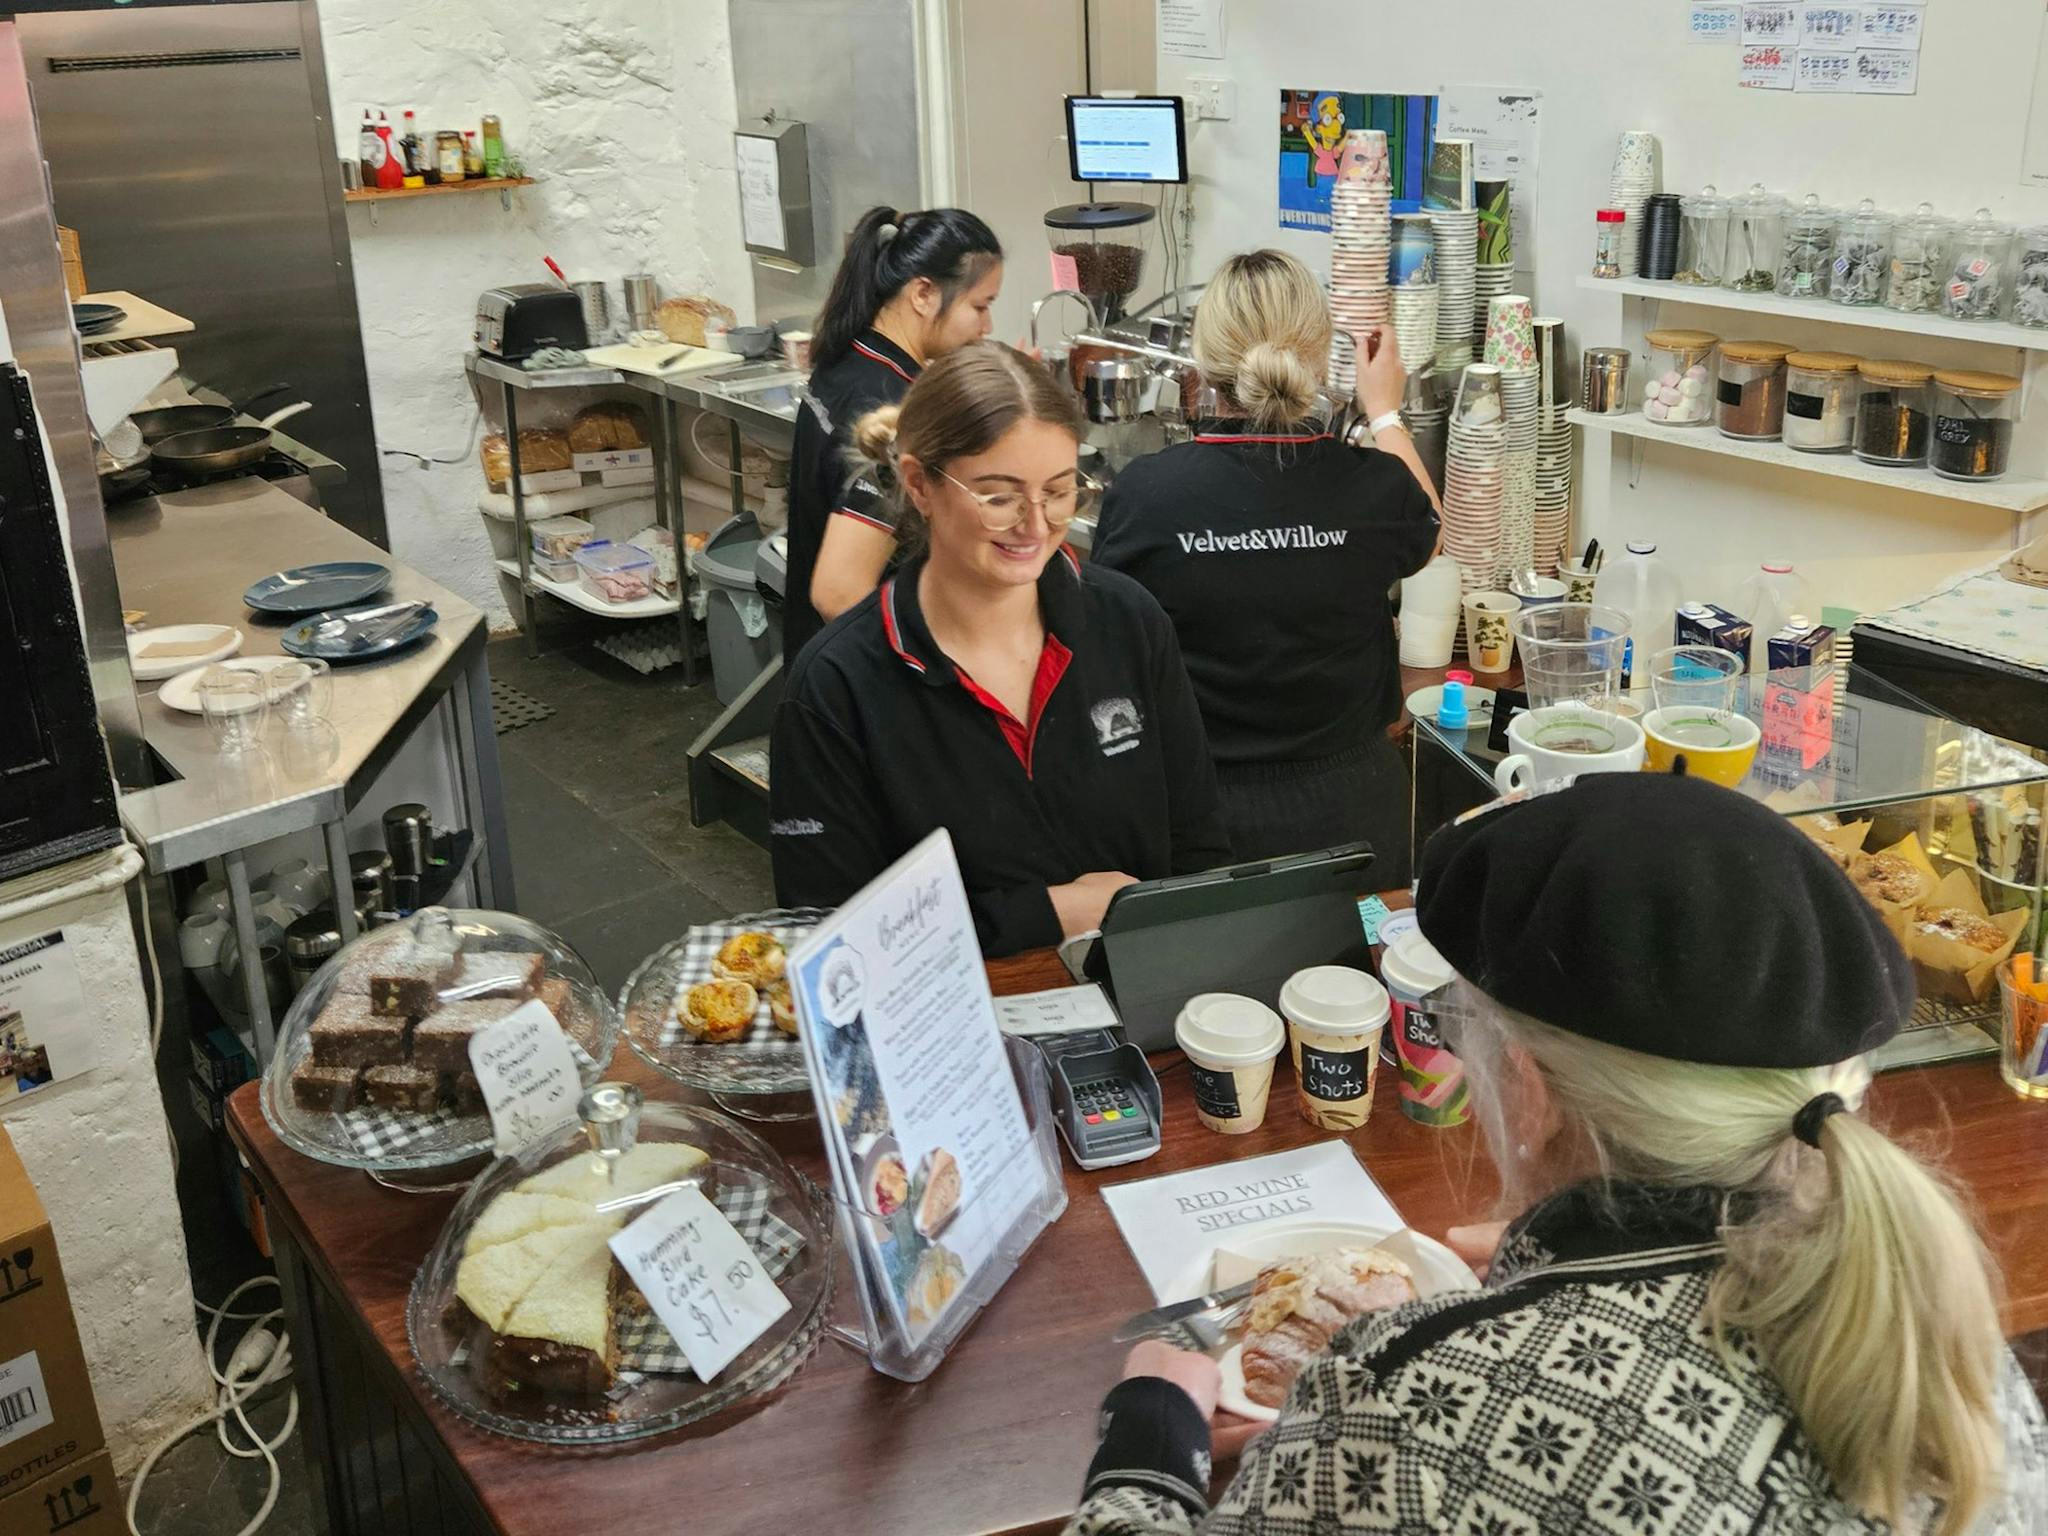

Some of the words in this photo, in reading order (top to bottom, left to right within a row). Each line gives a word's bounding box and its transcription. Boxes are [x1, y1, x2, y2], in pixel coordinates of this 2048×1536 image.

[1937, 416, 1968, 433] EARL
[1940, 431, 1970, 444] GREY
[1176, 525, 1348, 554] Velvet&Willow
[877, 877, 942, 951] Breakfast
[1307, 1053, 1352, 1075] Two
[1308, 1077, 1363, 1097] Shots
[1175, 1189, 1231, 1213] RED
[1236, 1173, 1309, 1200] WINE
[1196, 1194, 1314, 1232] SPECIALS
[661, 1245, 691, 1282] Bird
[666, 1264, 709, 1307] Cake
